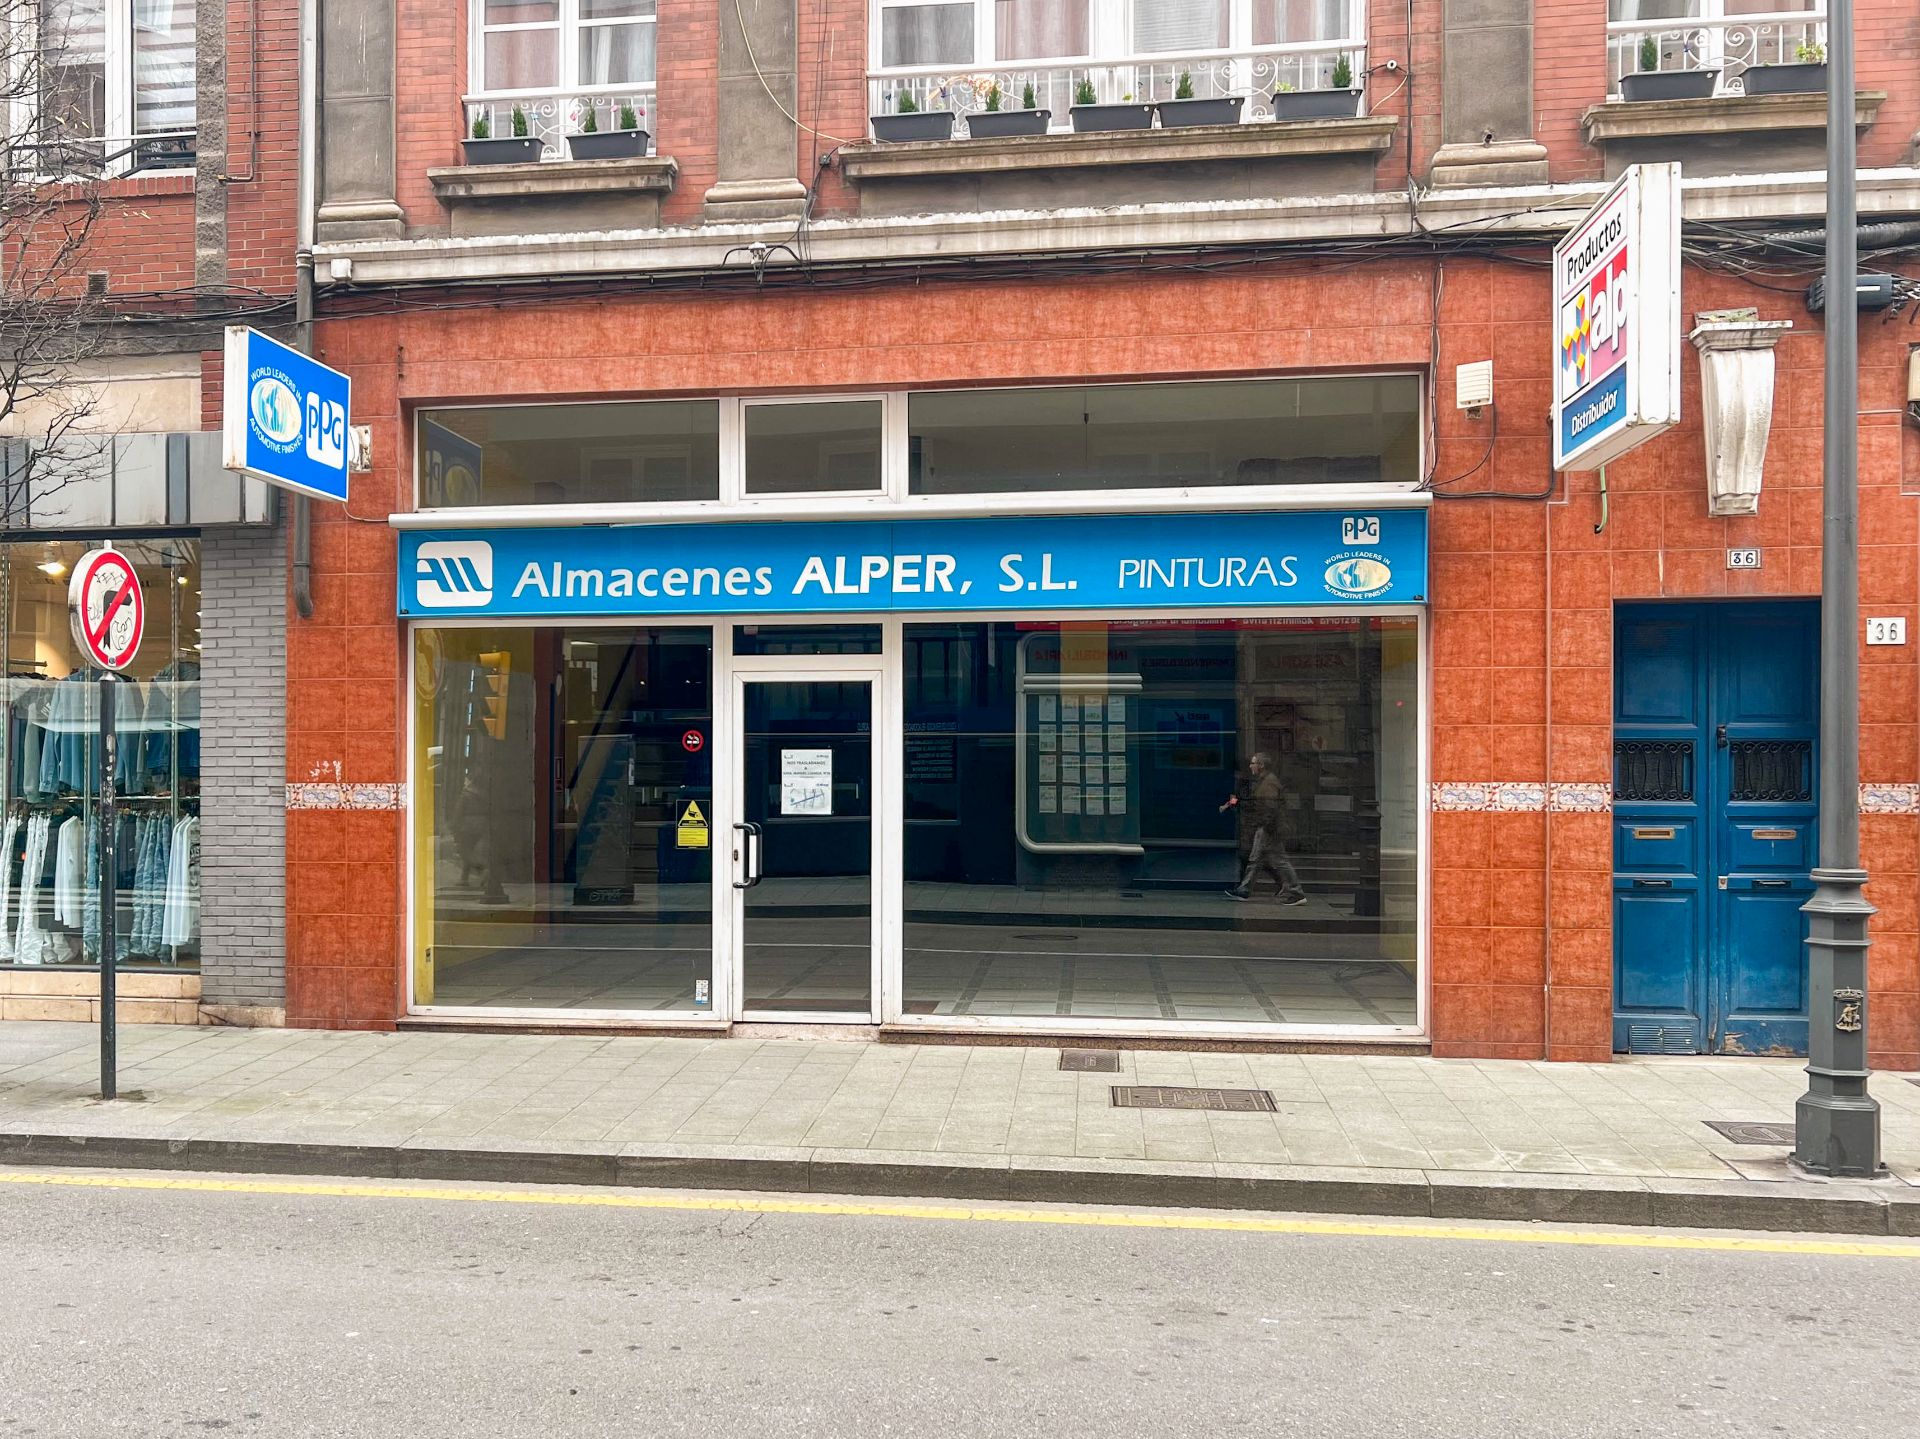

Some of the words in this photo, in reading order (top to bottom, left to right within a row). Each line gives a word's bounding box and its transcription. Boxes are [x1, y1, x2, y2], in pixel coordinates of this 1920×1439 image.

[1567, 211, 1622, 285] Productos
[1591, 262, 1628, 353] alp
[250, 366, 272, 382] WORLD
[272, 367, 296, 394] LEADERS
[296, 389, 303, 403] IN
[308, 400, 342, 451] PPG
[1571, 388, 1619, 438] Distribuidor
[249, 418, 281, 454] AUTOMOTIVE
[281, 432, 303, 454] FINISHES
[1344, 517, 1377, 540] PPG
[510, 561, 773, 598] Almacenes
[791, 554, 971, 596] ALPER,
[999, 552, 1079, 594] S.L.
[1117, 555, 1298, 590] PINTURAS
[1324, 551, 1350, 566] WORLD
[1351, 551, 1383, 561] LEADERS
[1383, 557, 1391, 566] IN
[1733, 552, 1754, 564] 36
[1323, 584, 1363, 600] AUTOMOTIVE
[1364, 581, 1394, 599] FINISHES
[1876, 622, 1898, 641] 36
